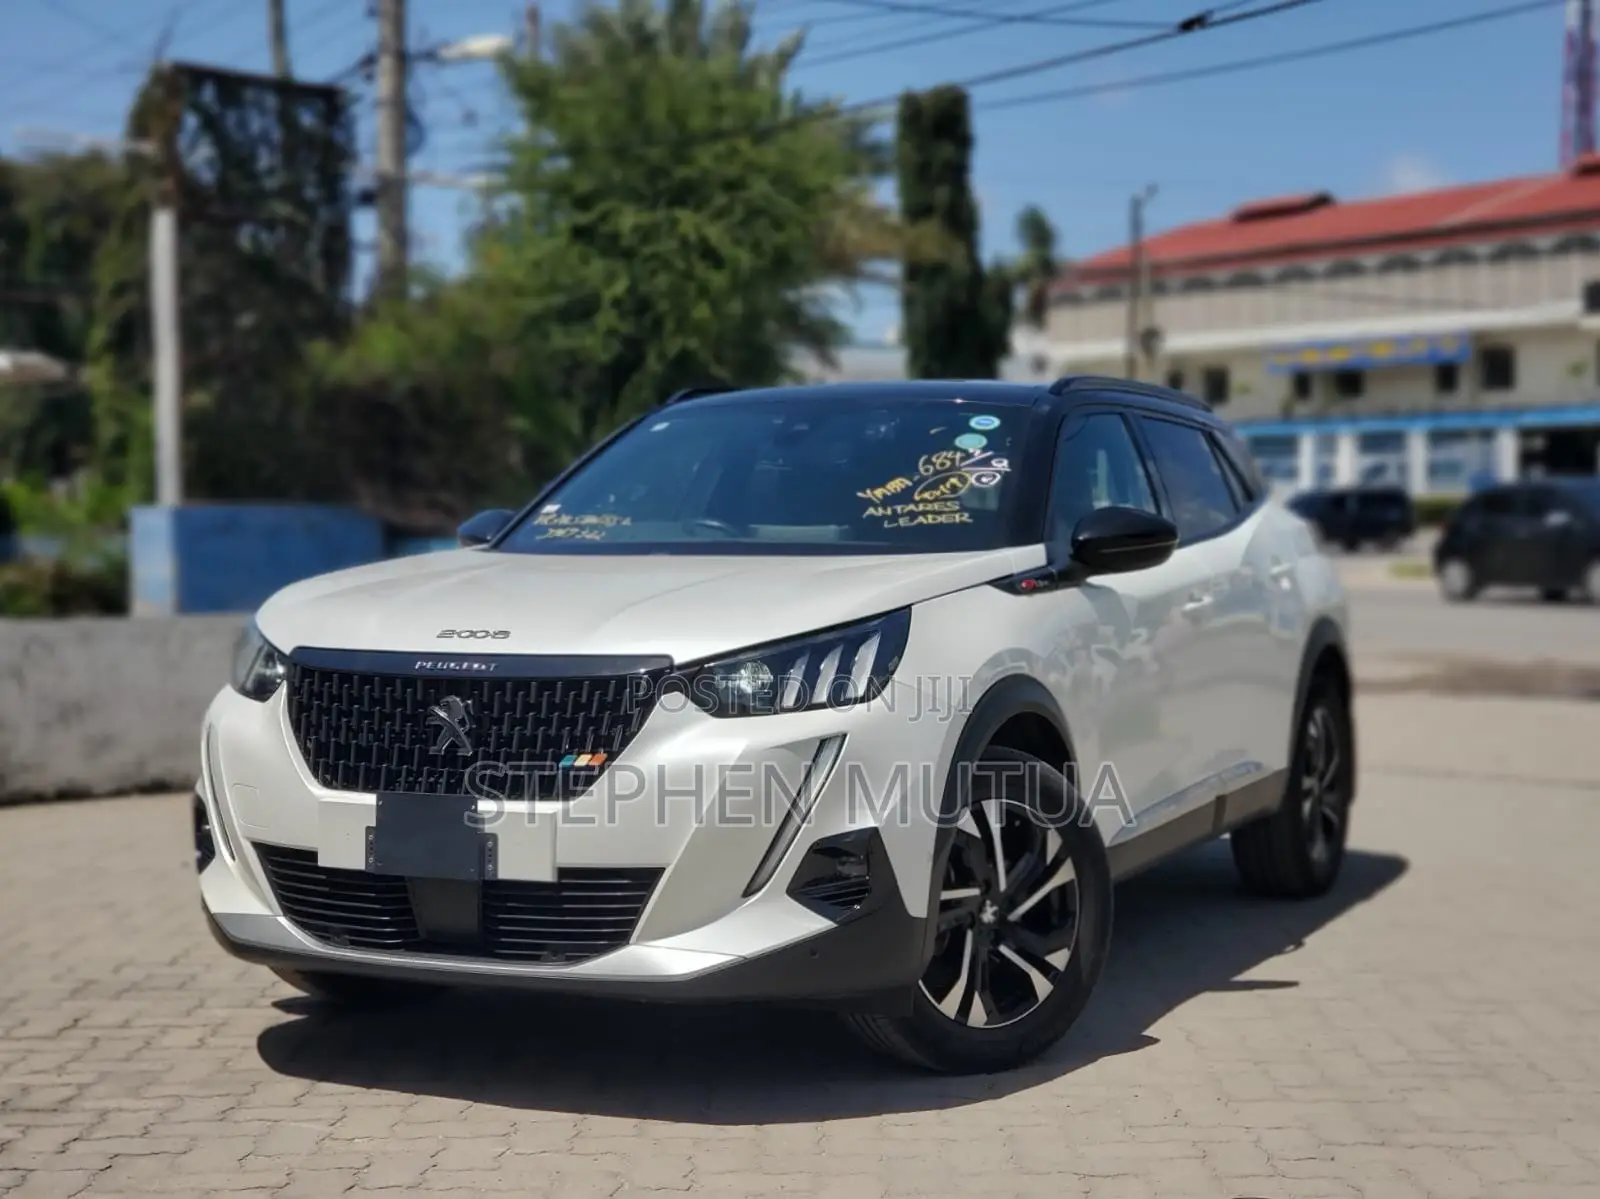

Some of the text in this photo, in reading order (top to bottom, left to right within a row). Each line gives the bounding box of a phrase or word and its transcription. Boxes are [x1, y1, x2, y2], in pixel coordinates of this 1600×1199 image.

[863, 501, 960, 519] ANTARES
[884, 512, 973, 528] LEADER
[436, 629, 511, 639] 2008
[414, 660, 498, 672] PEUGEOT
